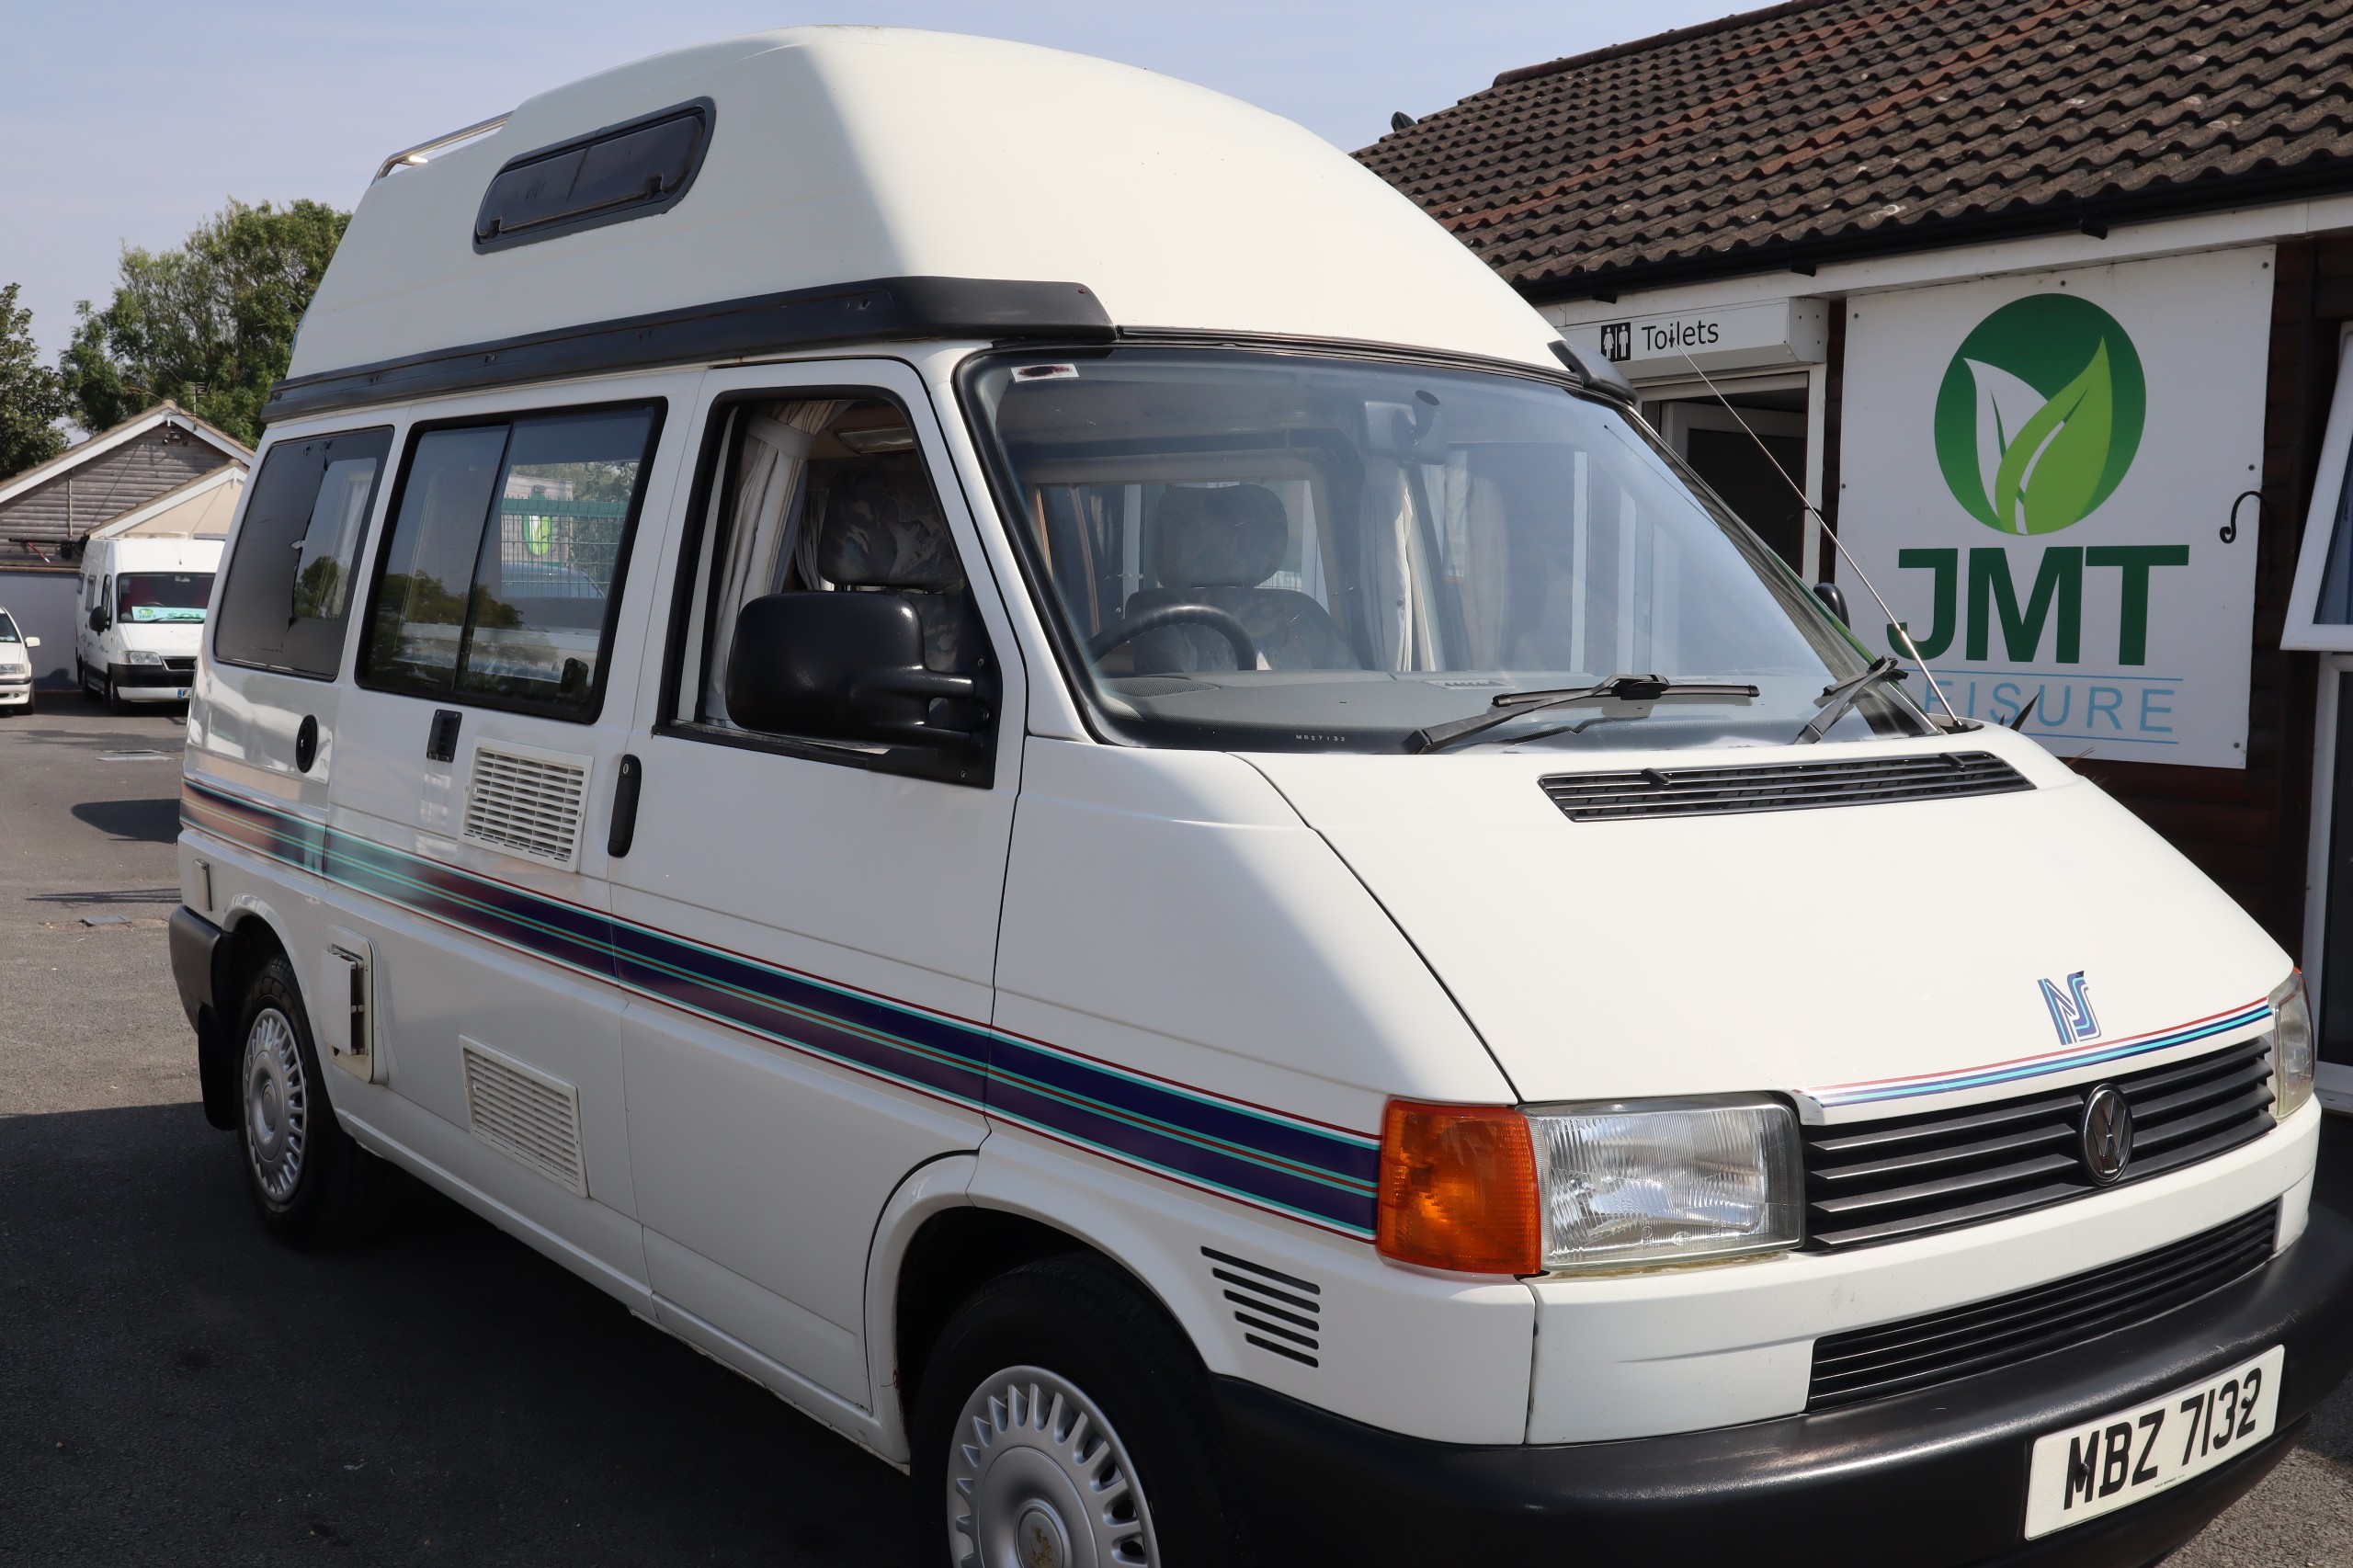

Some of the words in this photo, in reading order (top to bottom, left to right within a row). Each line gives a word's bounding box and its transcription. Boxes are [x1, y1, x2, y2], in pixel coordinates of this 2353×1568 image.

[1642, 321, 1719, 351] Toilets
[1886, 544, 2190, 665] JMT
[1923, 680, 2176, 733] EISURE
[2063, 1408, 2165, 1510] MBZ
[2180, 1367, 2262, 1466] 7132
